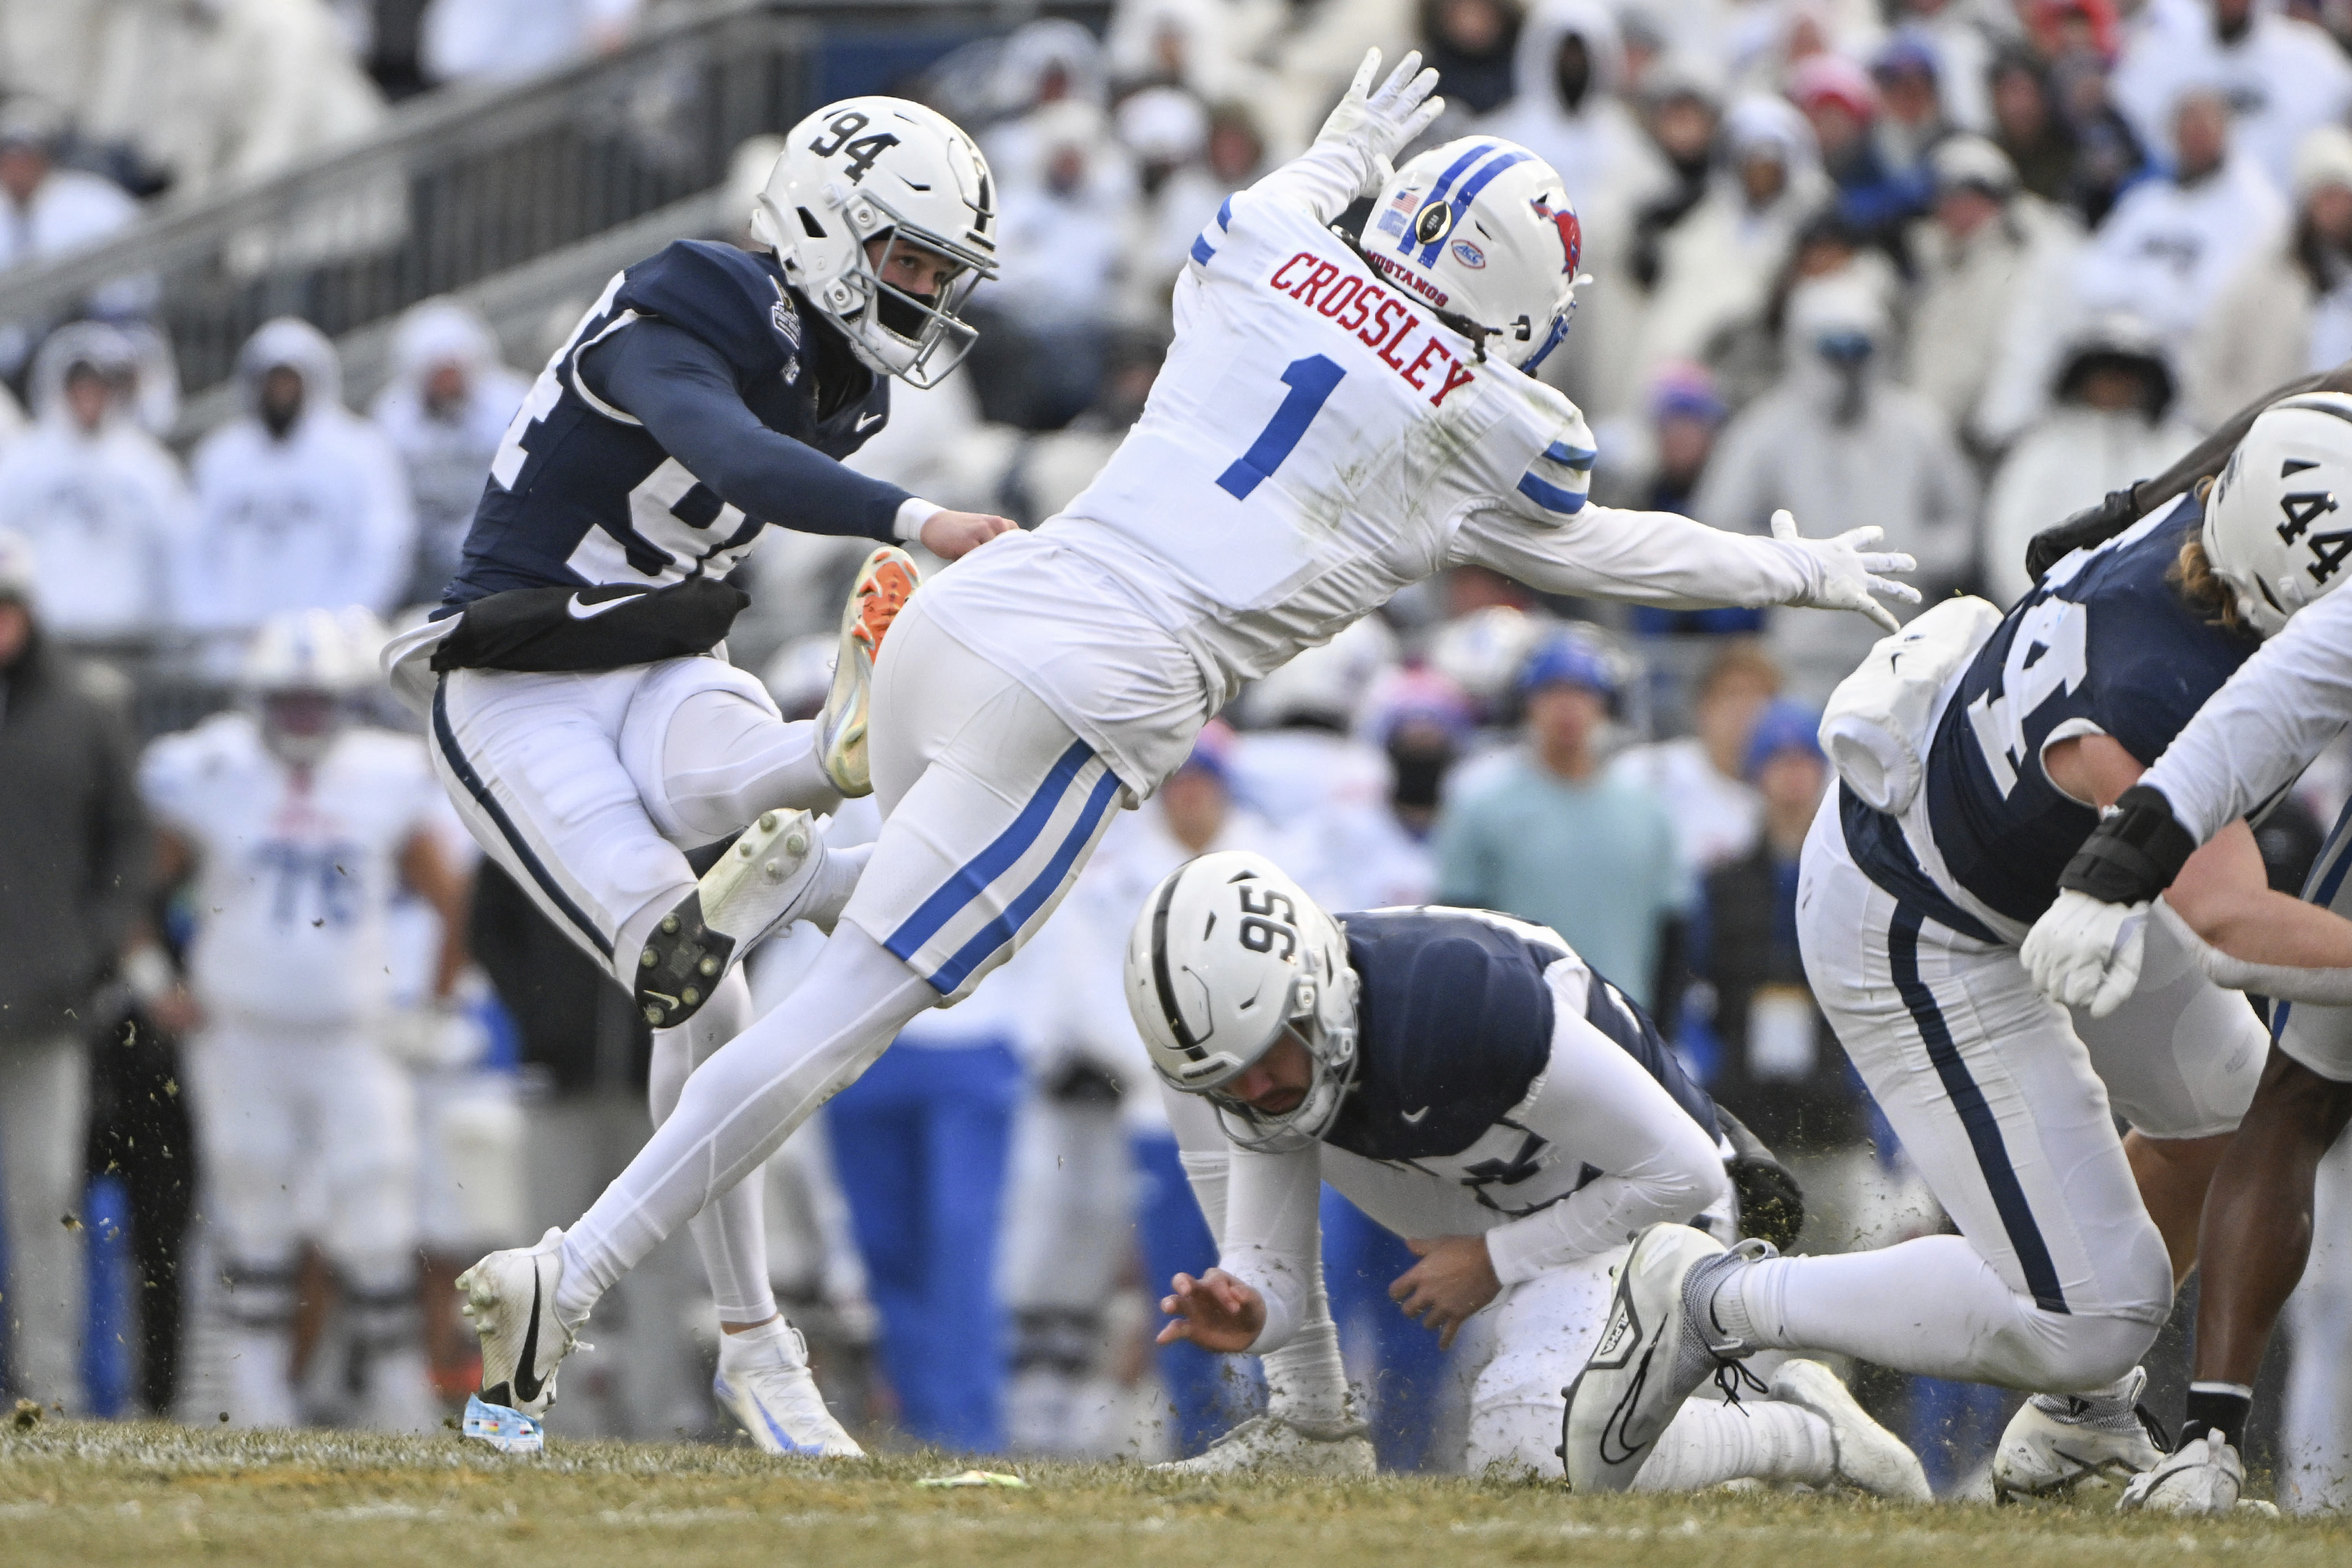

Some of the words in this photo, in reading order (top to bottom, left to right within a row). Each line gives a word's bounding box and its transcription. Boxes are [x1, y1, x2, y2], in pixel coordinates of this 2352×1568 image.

[808, 111, 901, 183] 94
[1453, 245, 1484, 265] ACC
[1270, 251, 1475, 408] CROSSLEY
[1215, 353, 1347, 501] 1
[2277, 489, 2352, 585] 44
[1239, 884, 1298, 966] 95
